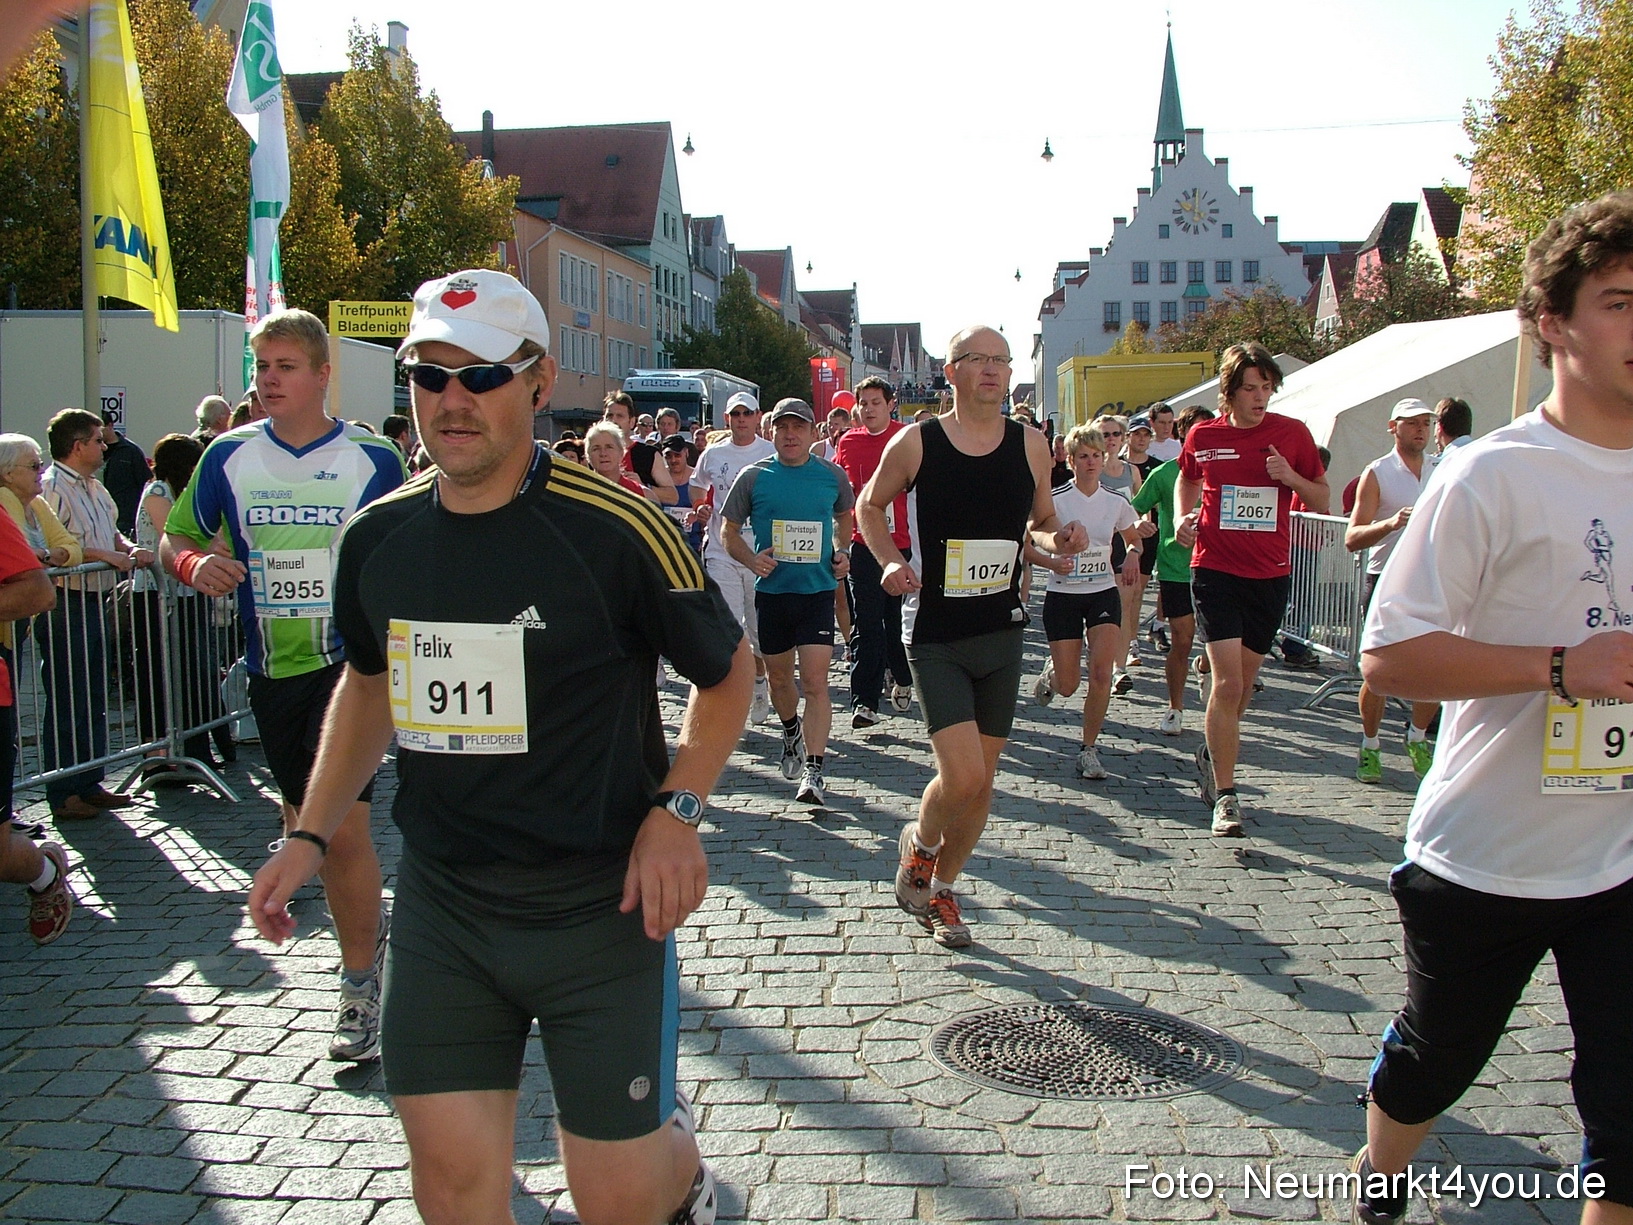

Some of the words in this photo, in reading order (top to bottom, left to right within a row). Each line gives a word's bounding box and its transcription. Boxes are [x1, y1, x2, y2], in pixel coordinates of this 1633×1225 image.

[338, 305, 407, 318] Treffpunkt
[338, 321, 411, 335] Bladenight
[250, 490, 292, 500] TEAM
[1236, 489, 1260, 499] Fabian
[246, 505, 346, 527] BOCK
[1237, 505, 1273, 518] 2067
[785, 525, 817, 534] Christoph
[791, 539, 814, 551] 122
[267, 556, 304, 570] Manuel
[1080, 562, 1106, 573] 2210
[968, 563, 1009, 580] 1074
[271, 580, 325, 600] 2955
[1586, 607, 1607, 628] 8.
[510, 619, 547, 630] adidas
[414, 634, 453, 658] Felix
[392, 669, 398, 686] C
[428, 680, 493, 715] 911
[1553, 722, 1562, 738] C
[465, 734, 525, 746] PFLEIDERER
[1543, 776, 1602, 787] BOCK
